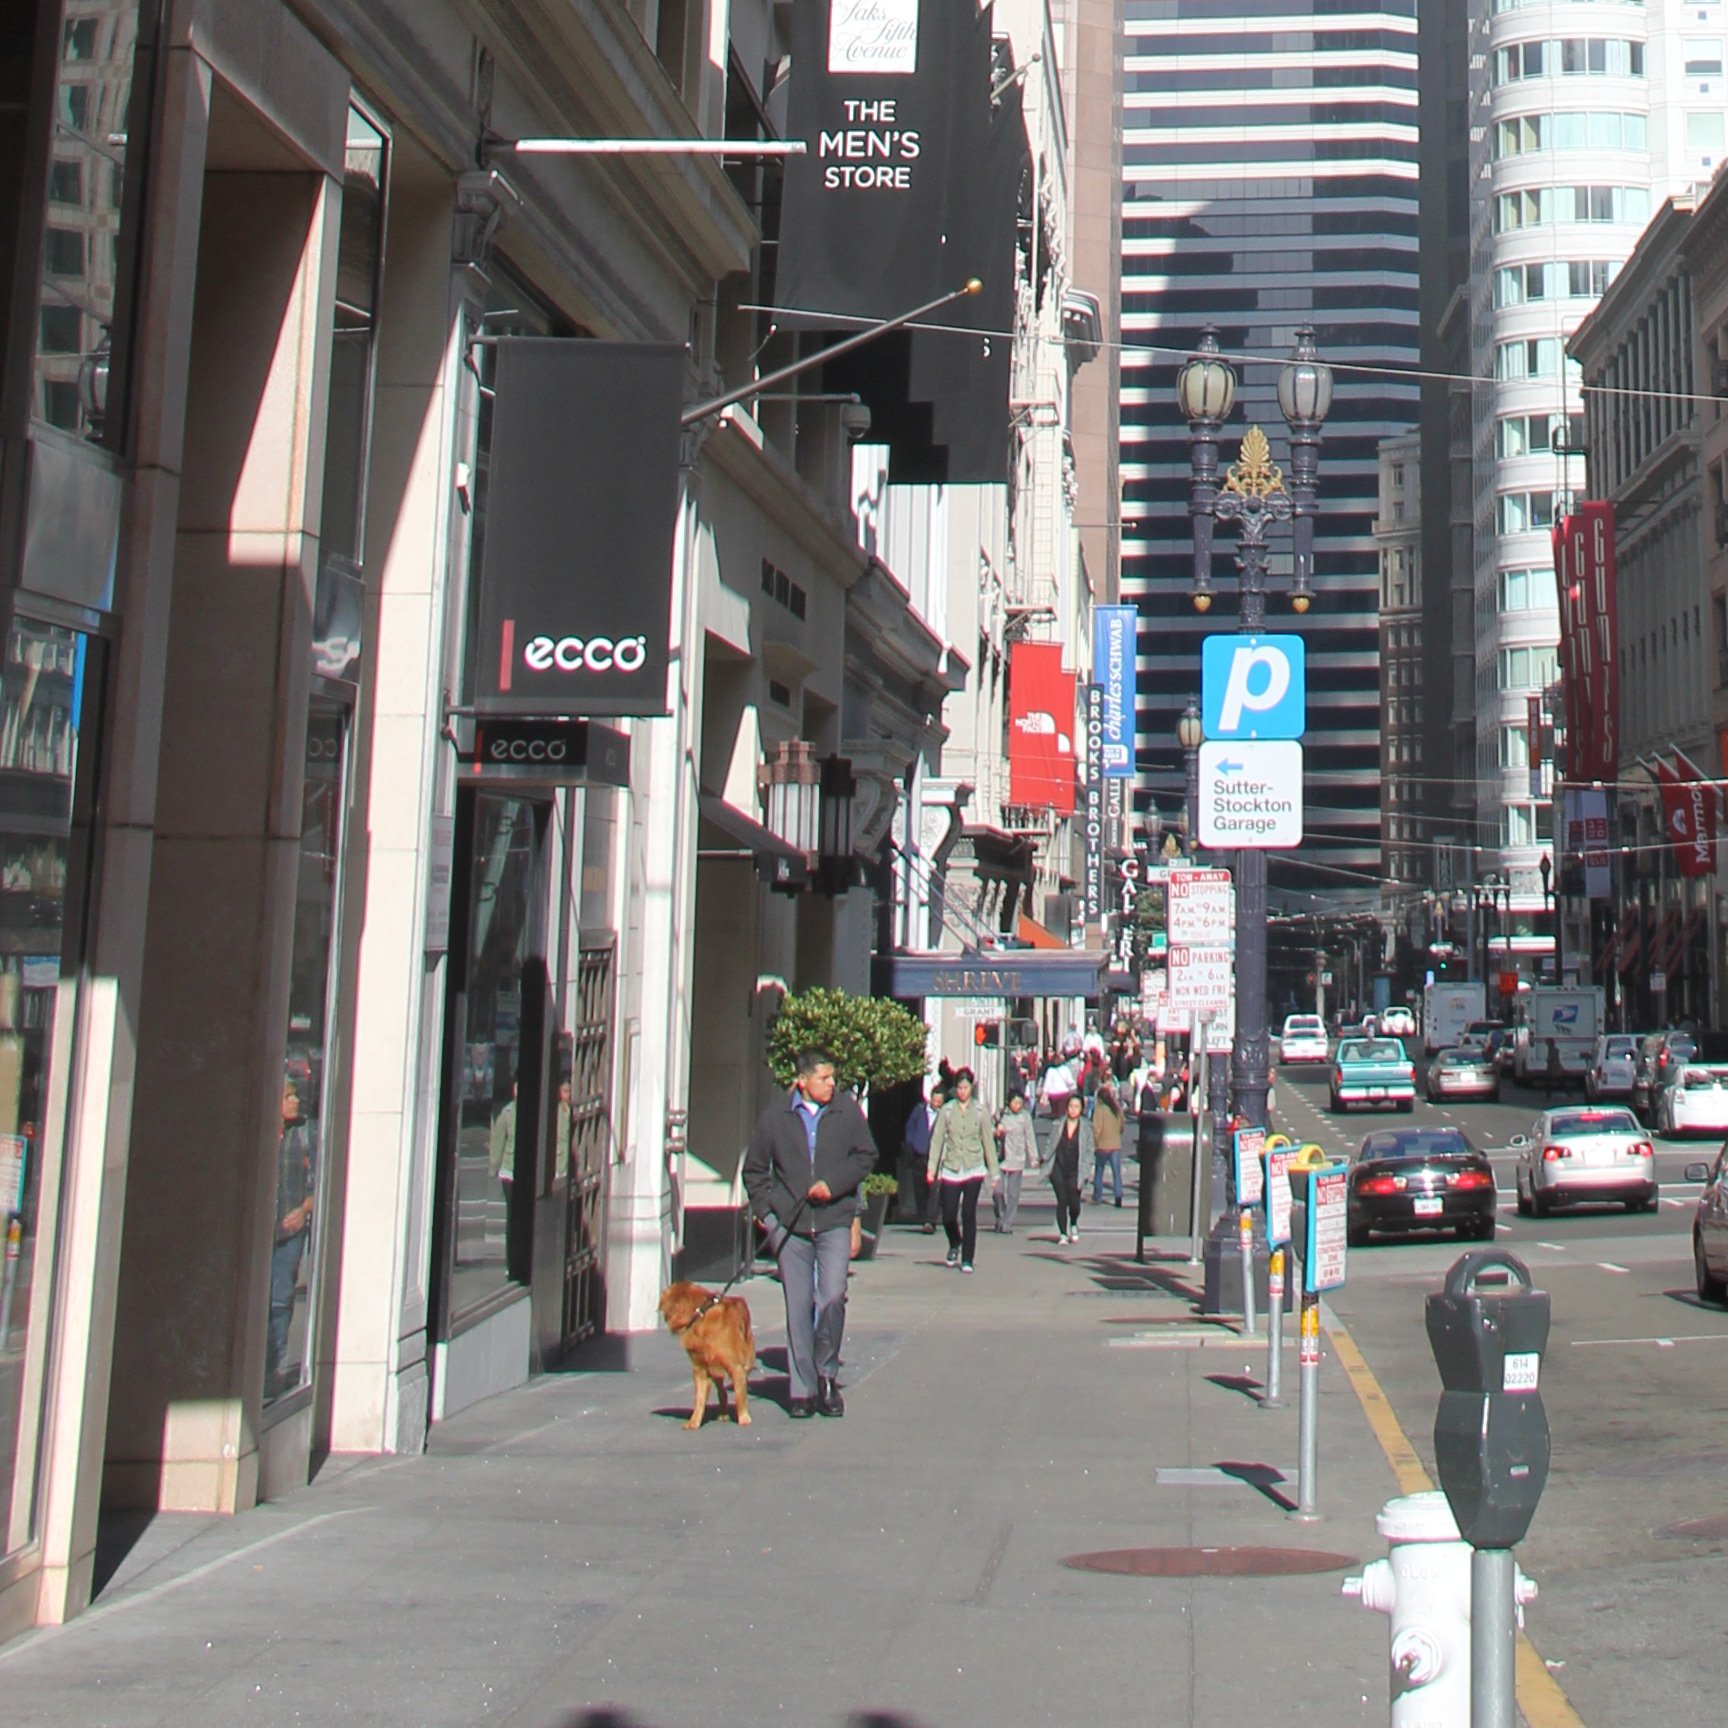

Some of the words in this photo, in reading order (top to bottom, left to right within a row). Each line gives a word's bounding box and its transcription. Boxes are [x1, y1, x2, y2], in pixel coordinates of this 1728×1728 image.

[831, 32, 908, 62] Avenue
[843, 100, 896, 122] THE
[819, 130, 920, 158] MEN'S
[824, 166, 911, 189] STORE
[524, 634, 648, 672] ecco
[1108, 618, 1123, 682] SCHWAB
[1089, 690, 1101, 780] BROOKS
[490, 738, 568, 761] ecco
[1213, 779, 1274, 795] Sutter-
[1213, 797, 1293, 814] Stockton
[1213, 815, 1277, 834] Garage
[1691, 783, 1711, 864] Marmo
[1087, 791, 1101, 914] BROTHERS
[1171, 883, 1188, 898] NO
[1171, 948, 1189, 965] NO
[1192, 951, 1229, 964] PARKING
[933, 971, 1022, 992] SHREVE
[963, 1008, 996, 1016] GRANT
[1512, 1357, 1529, 1370] 614
[1504, 1372, 1535, 1385] 02220
